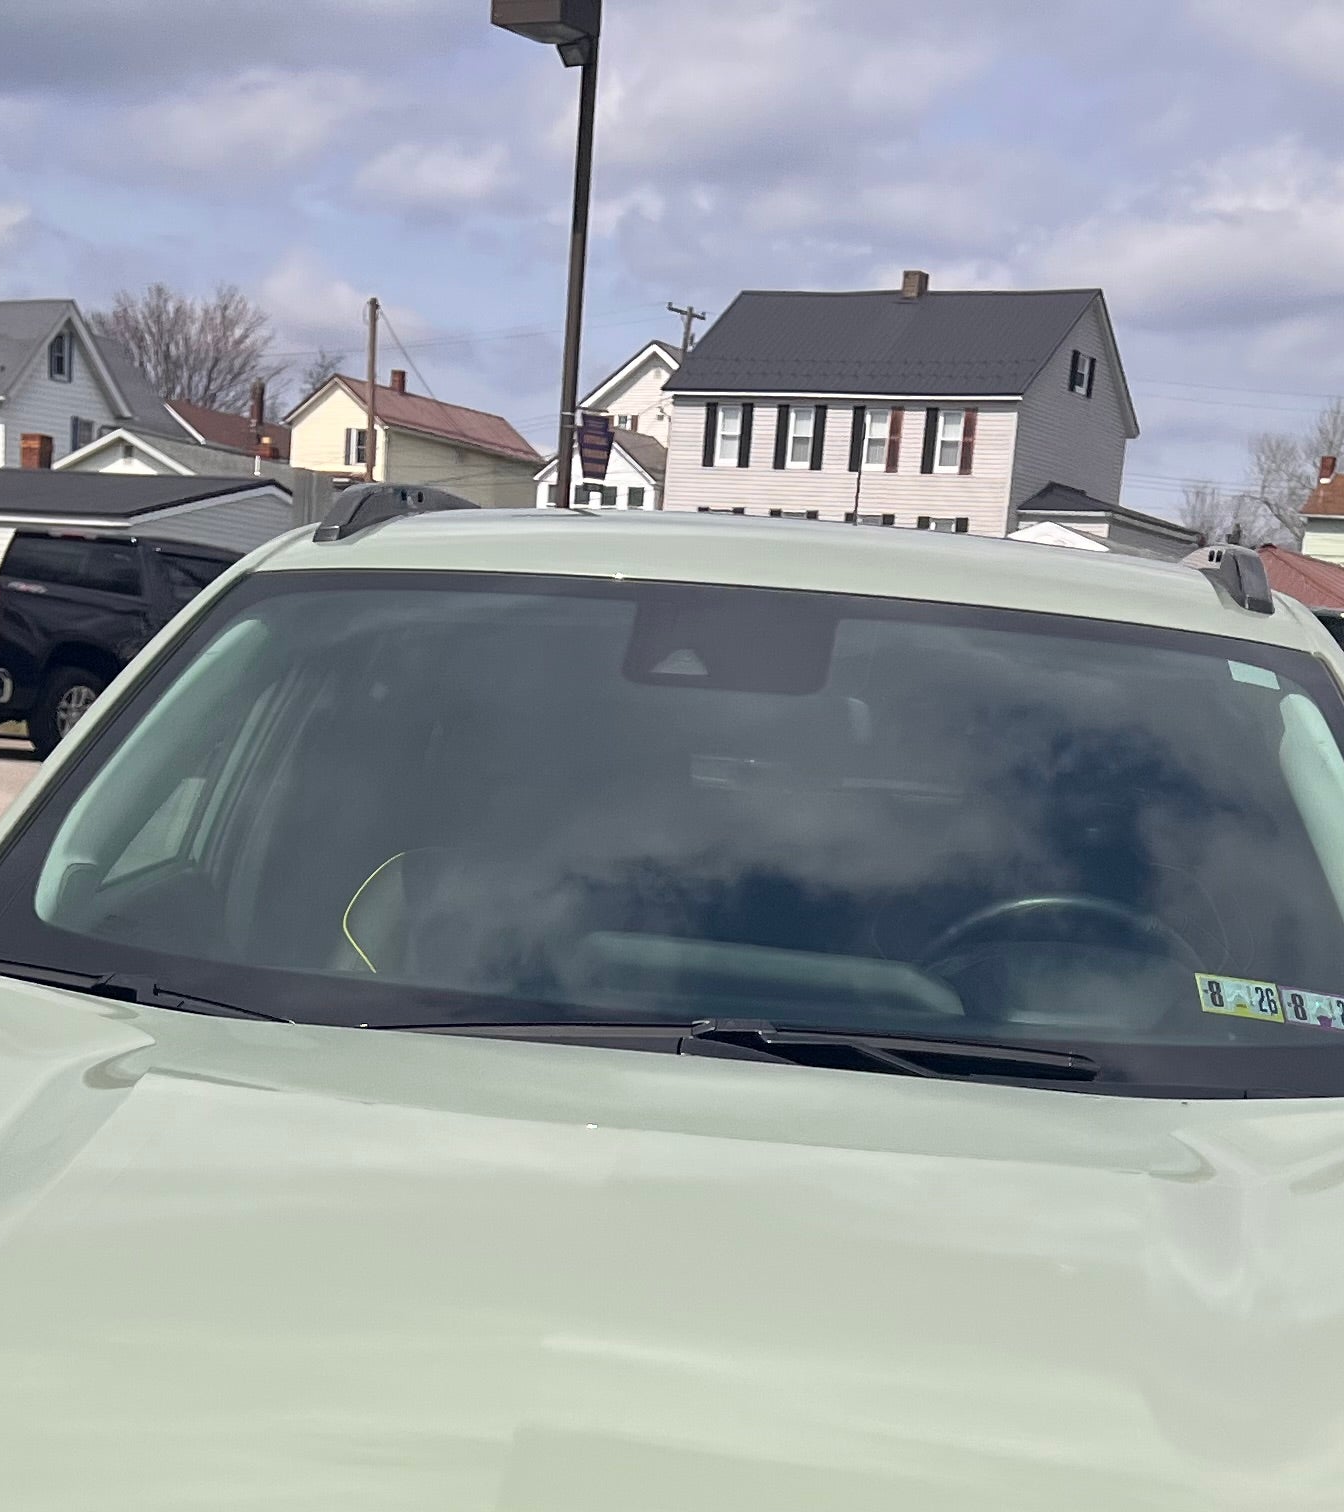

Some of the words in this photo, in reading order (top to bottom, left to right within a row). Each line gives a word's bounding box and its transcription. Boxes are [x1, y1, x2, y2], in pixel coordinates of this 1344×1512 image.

[1207, 980, 1224, 1007] 8
[1254, 986, 1279, 1014] 26
[1290, 993, 1308, 1020] 8
